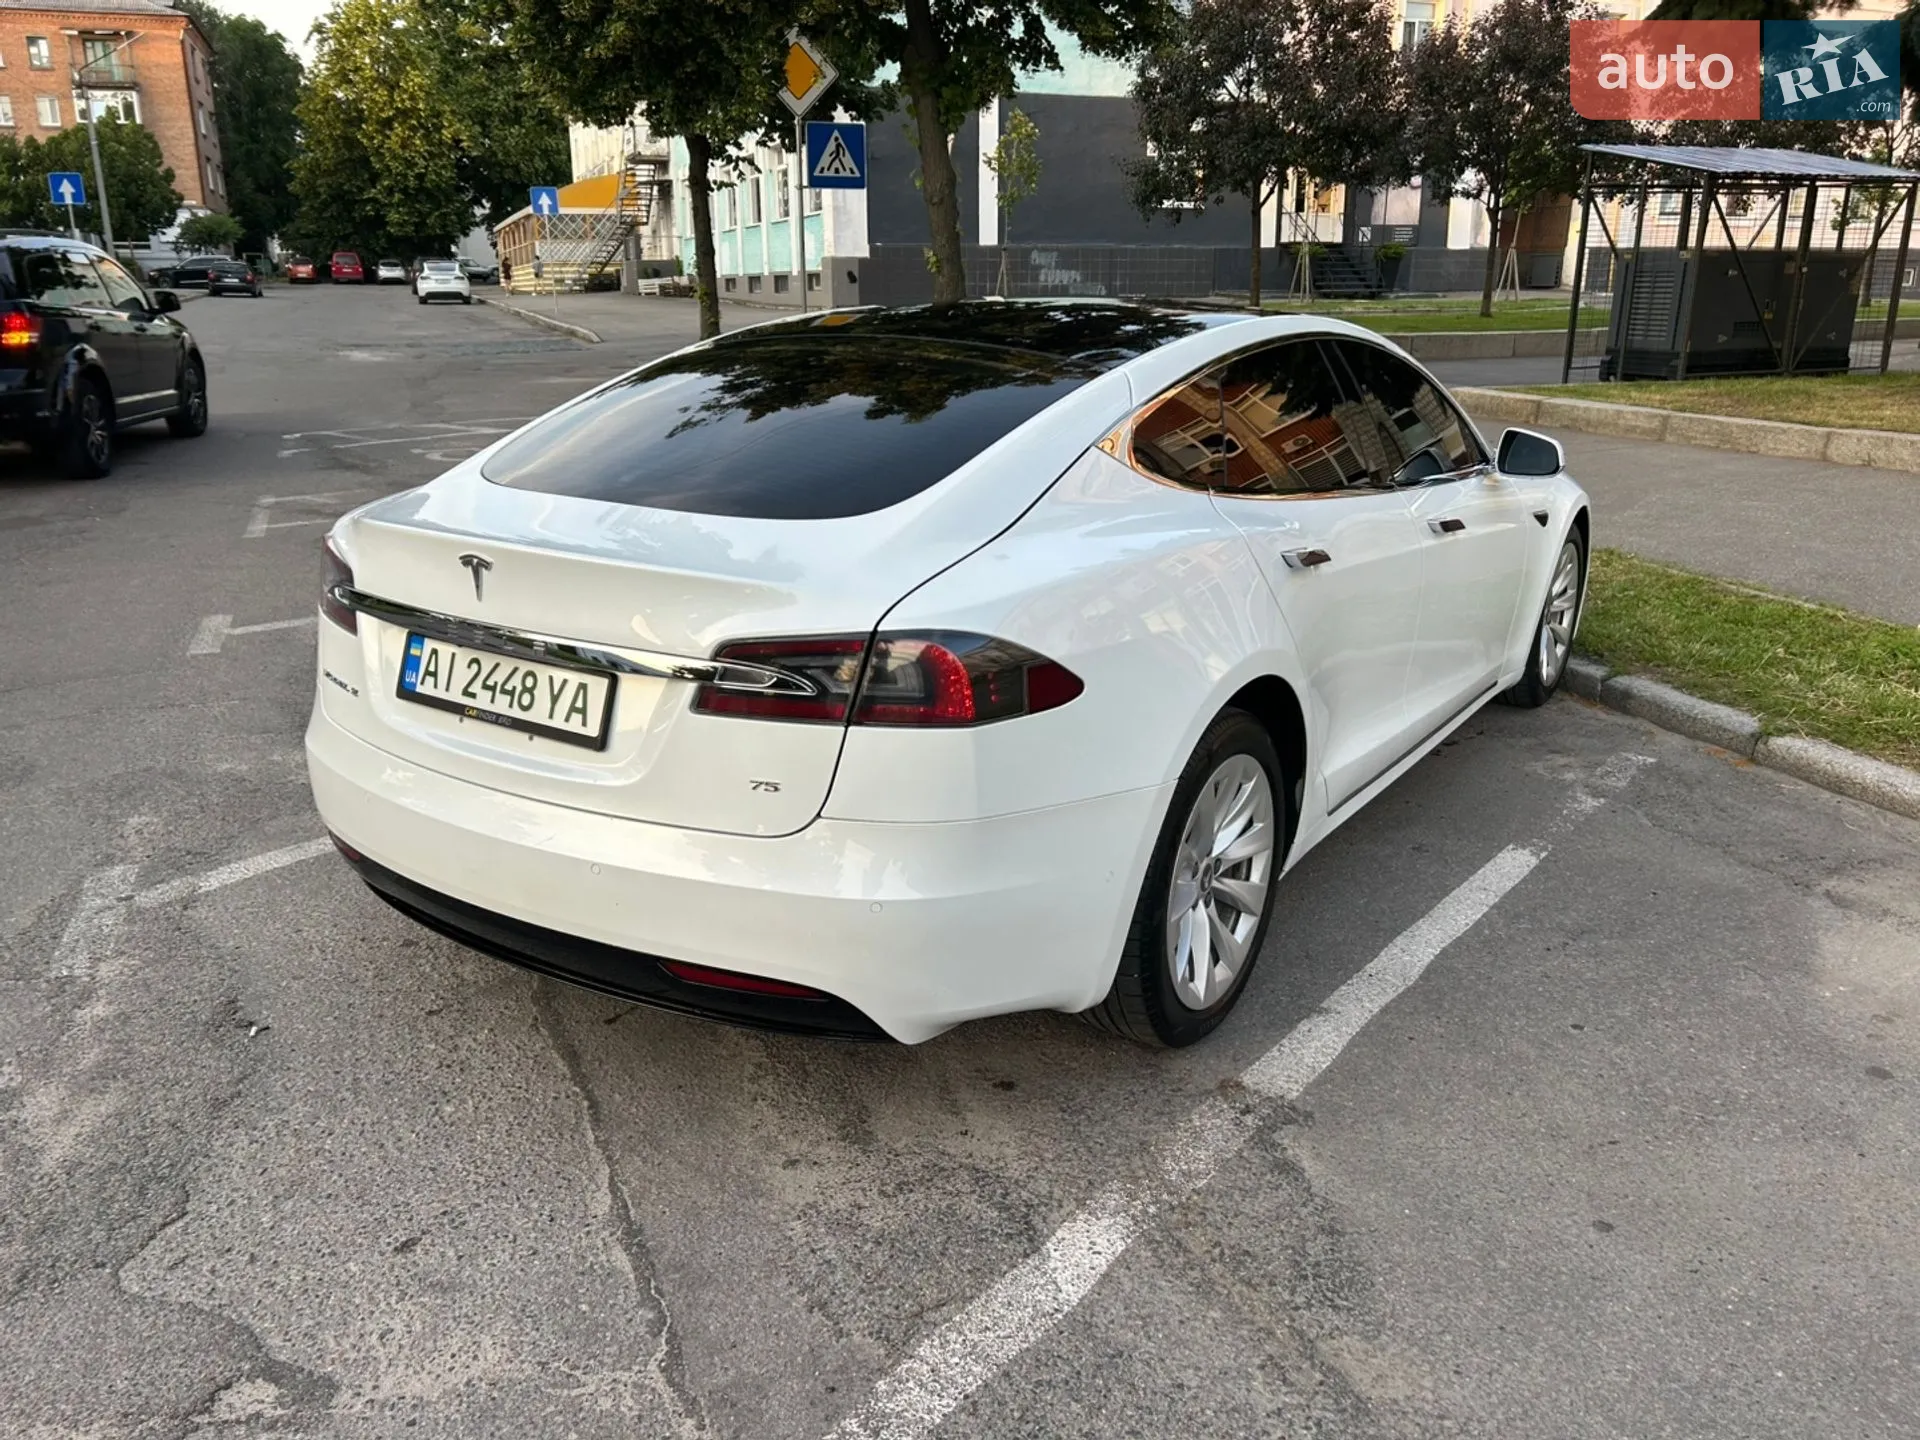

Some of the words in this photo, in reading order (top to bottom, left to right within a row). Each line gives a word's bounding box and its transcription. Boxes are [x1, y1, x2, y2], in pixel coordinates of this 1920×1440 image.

[405, 669, 416, 684] UA
[419, 646, 456, 693] AI
[461, 656, 539, 712] 2448
[547, 674, 589, 727] YA
[749, 779, 781, 793] 75
